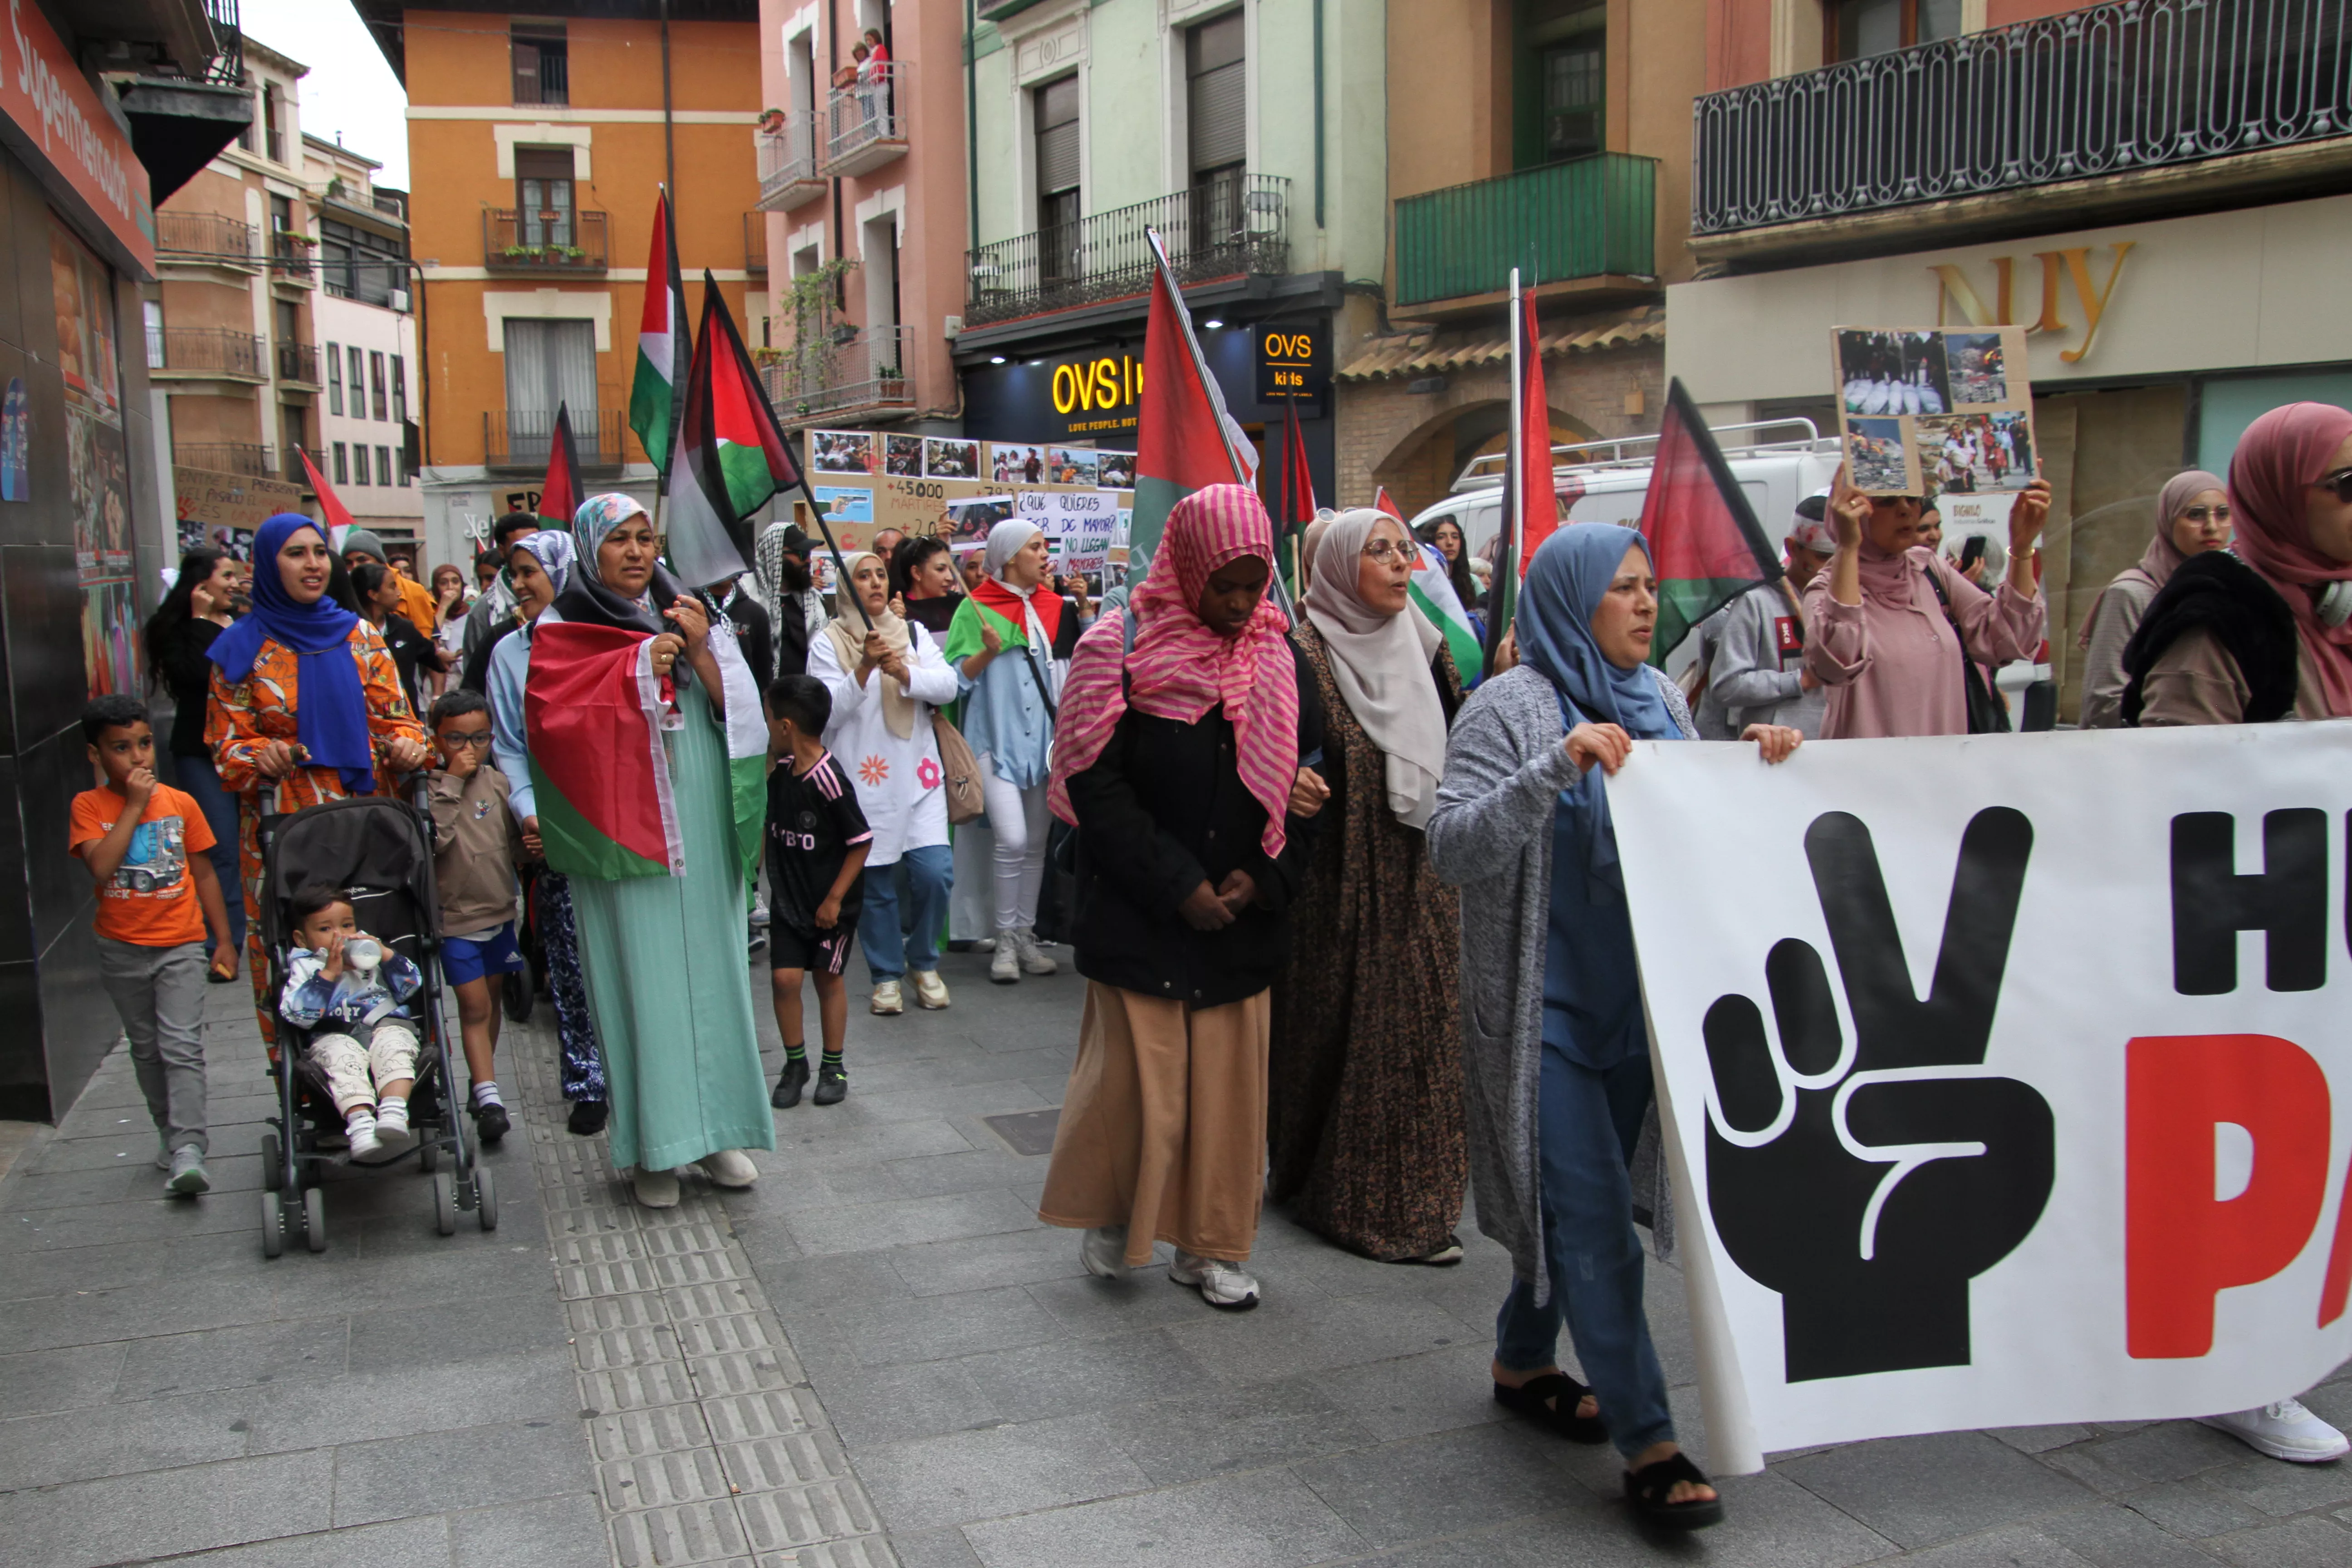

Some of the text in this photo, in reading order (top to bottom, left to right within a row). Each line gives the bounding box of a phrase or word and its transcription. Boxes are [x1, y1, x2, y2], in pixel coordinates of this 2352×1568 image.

[10, 0, 130, 221] Supermercado
[1265, 333, 1312, 358] OVS
[1053, 357, 1121, 414] OVS
[1068, 417, 1137, 432] LOVE PEOPLE. NOT
[252, 478, 301, 497] PRESENTE
[1019, 493, 1046, 512] ¿QUÉ
[199, 505, 263, 524] ES UNO
[1083, 514, 1116, 533] MAYOR?
[1065, 537, 1110, 554] NO LLEGAN
[1066, 556, 1104, 572] MAYORES
[2171, 807, 2352, 996] H
[2126, 1034, 2352, 1358] P
